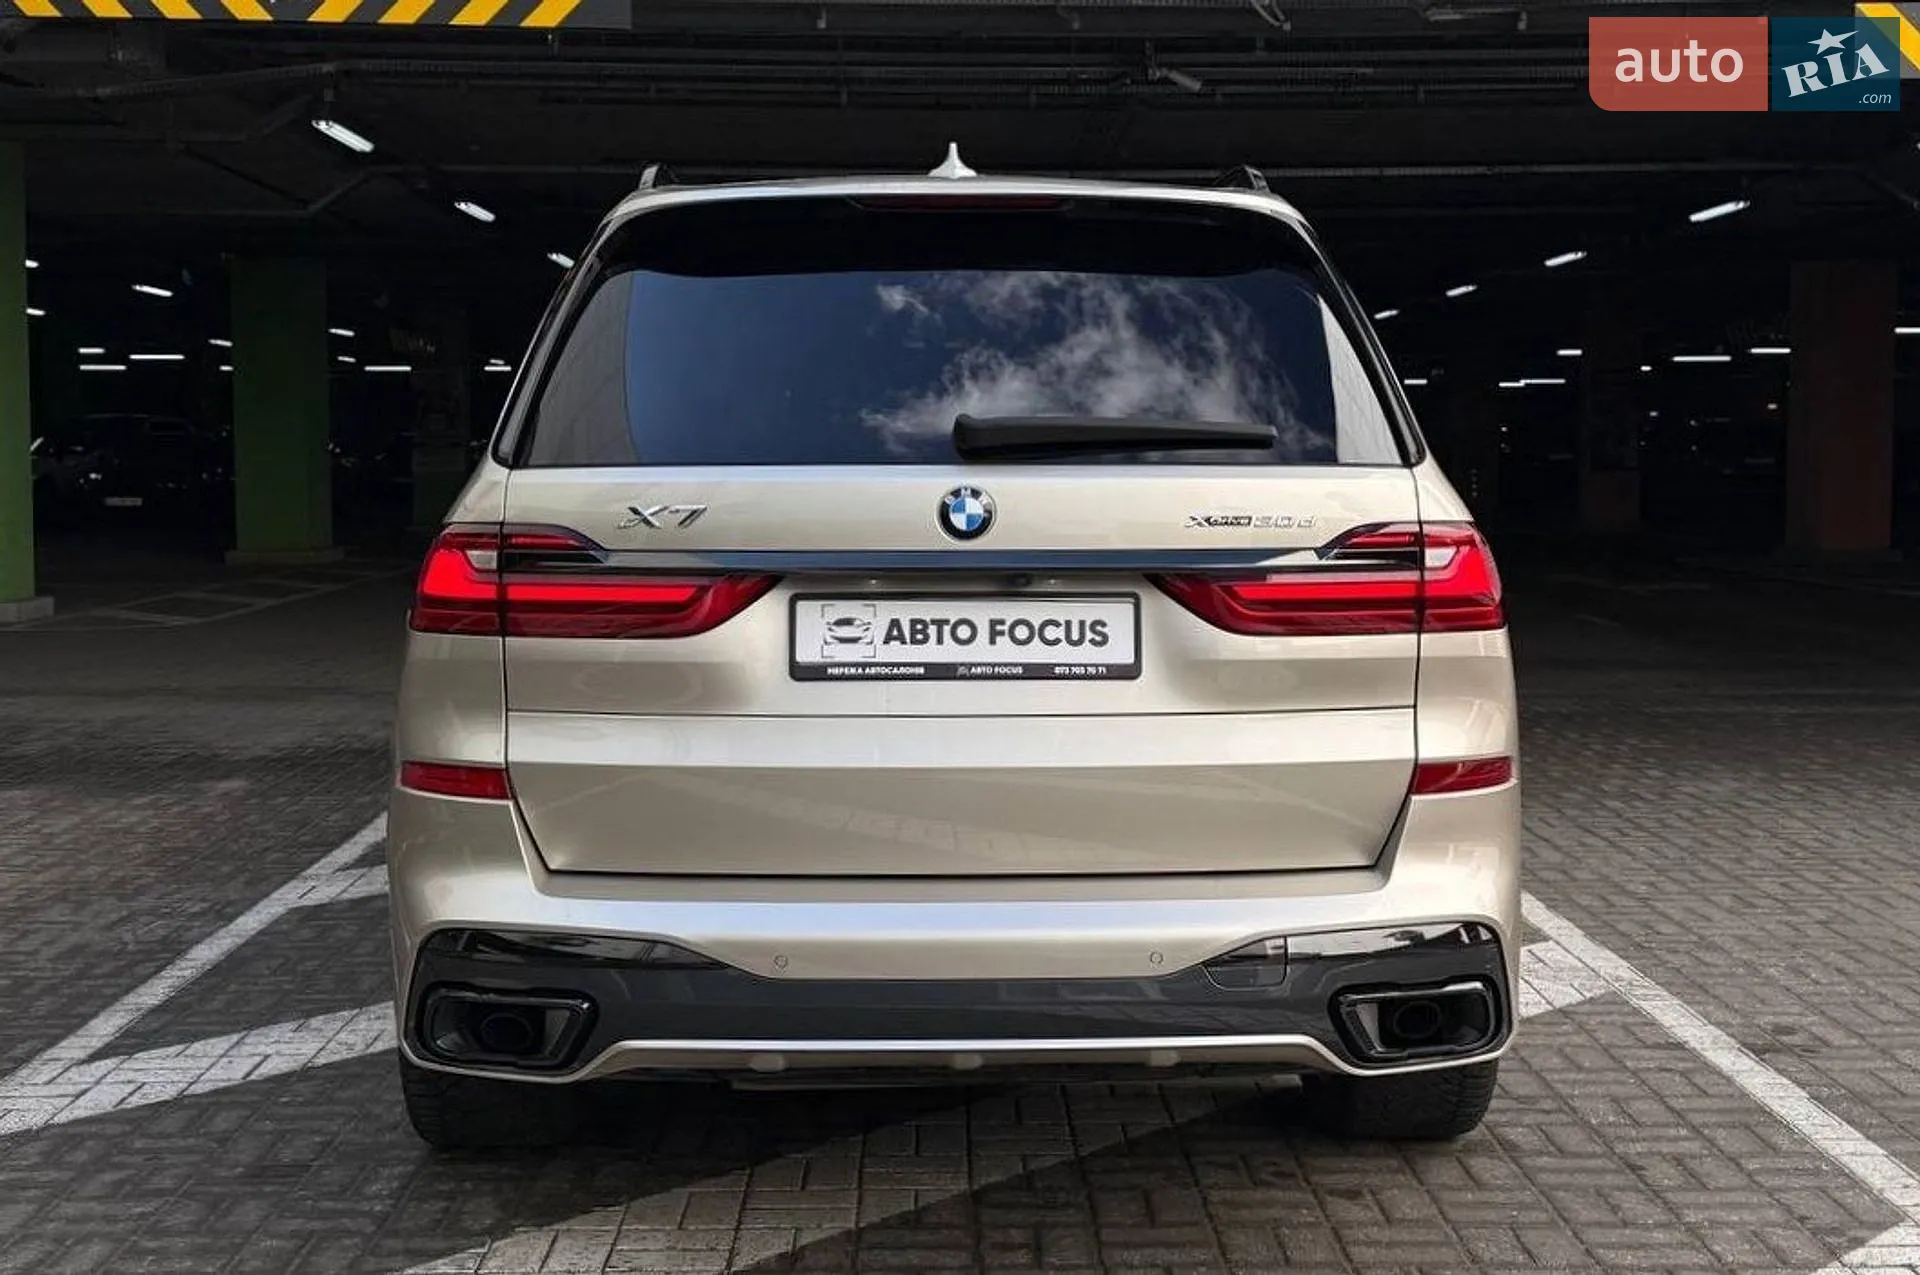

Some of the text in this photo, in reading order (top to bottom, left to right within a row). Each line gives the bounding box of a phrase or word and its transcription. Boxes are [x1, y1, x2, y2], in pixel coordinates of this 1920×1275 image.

[617, 504, 708, 530] X7
[988, 618, 1110, 648] FOCUS
[994, 666, 1024, 675] FOCUS
